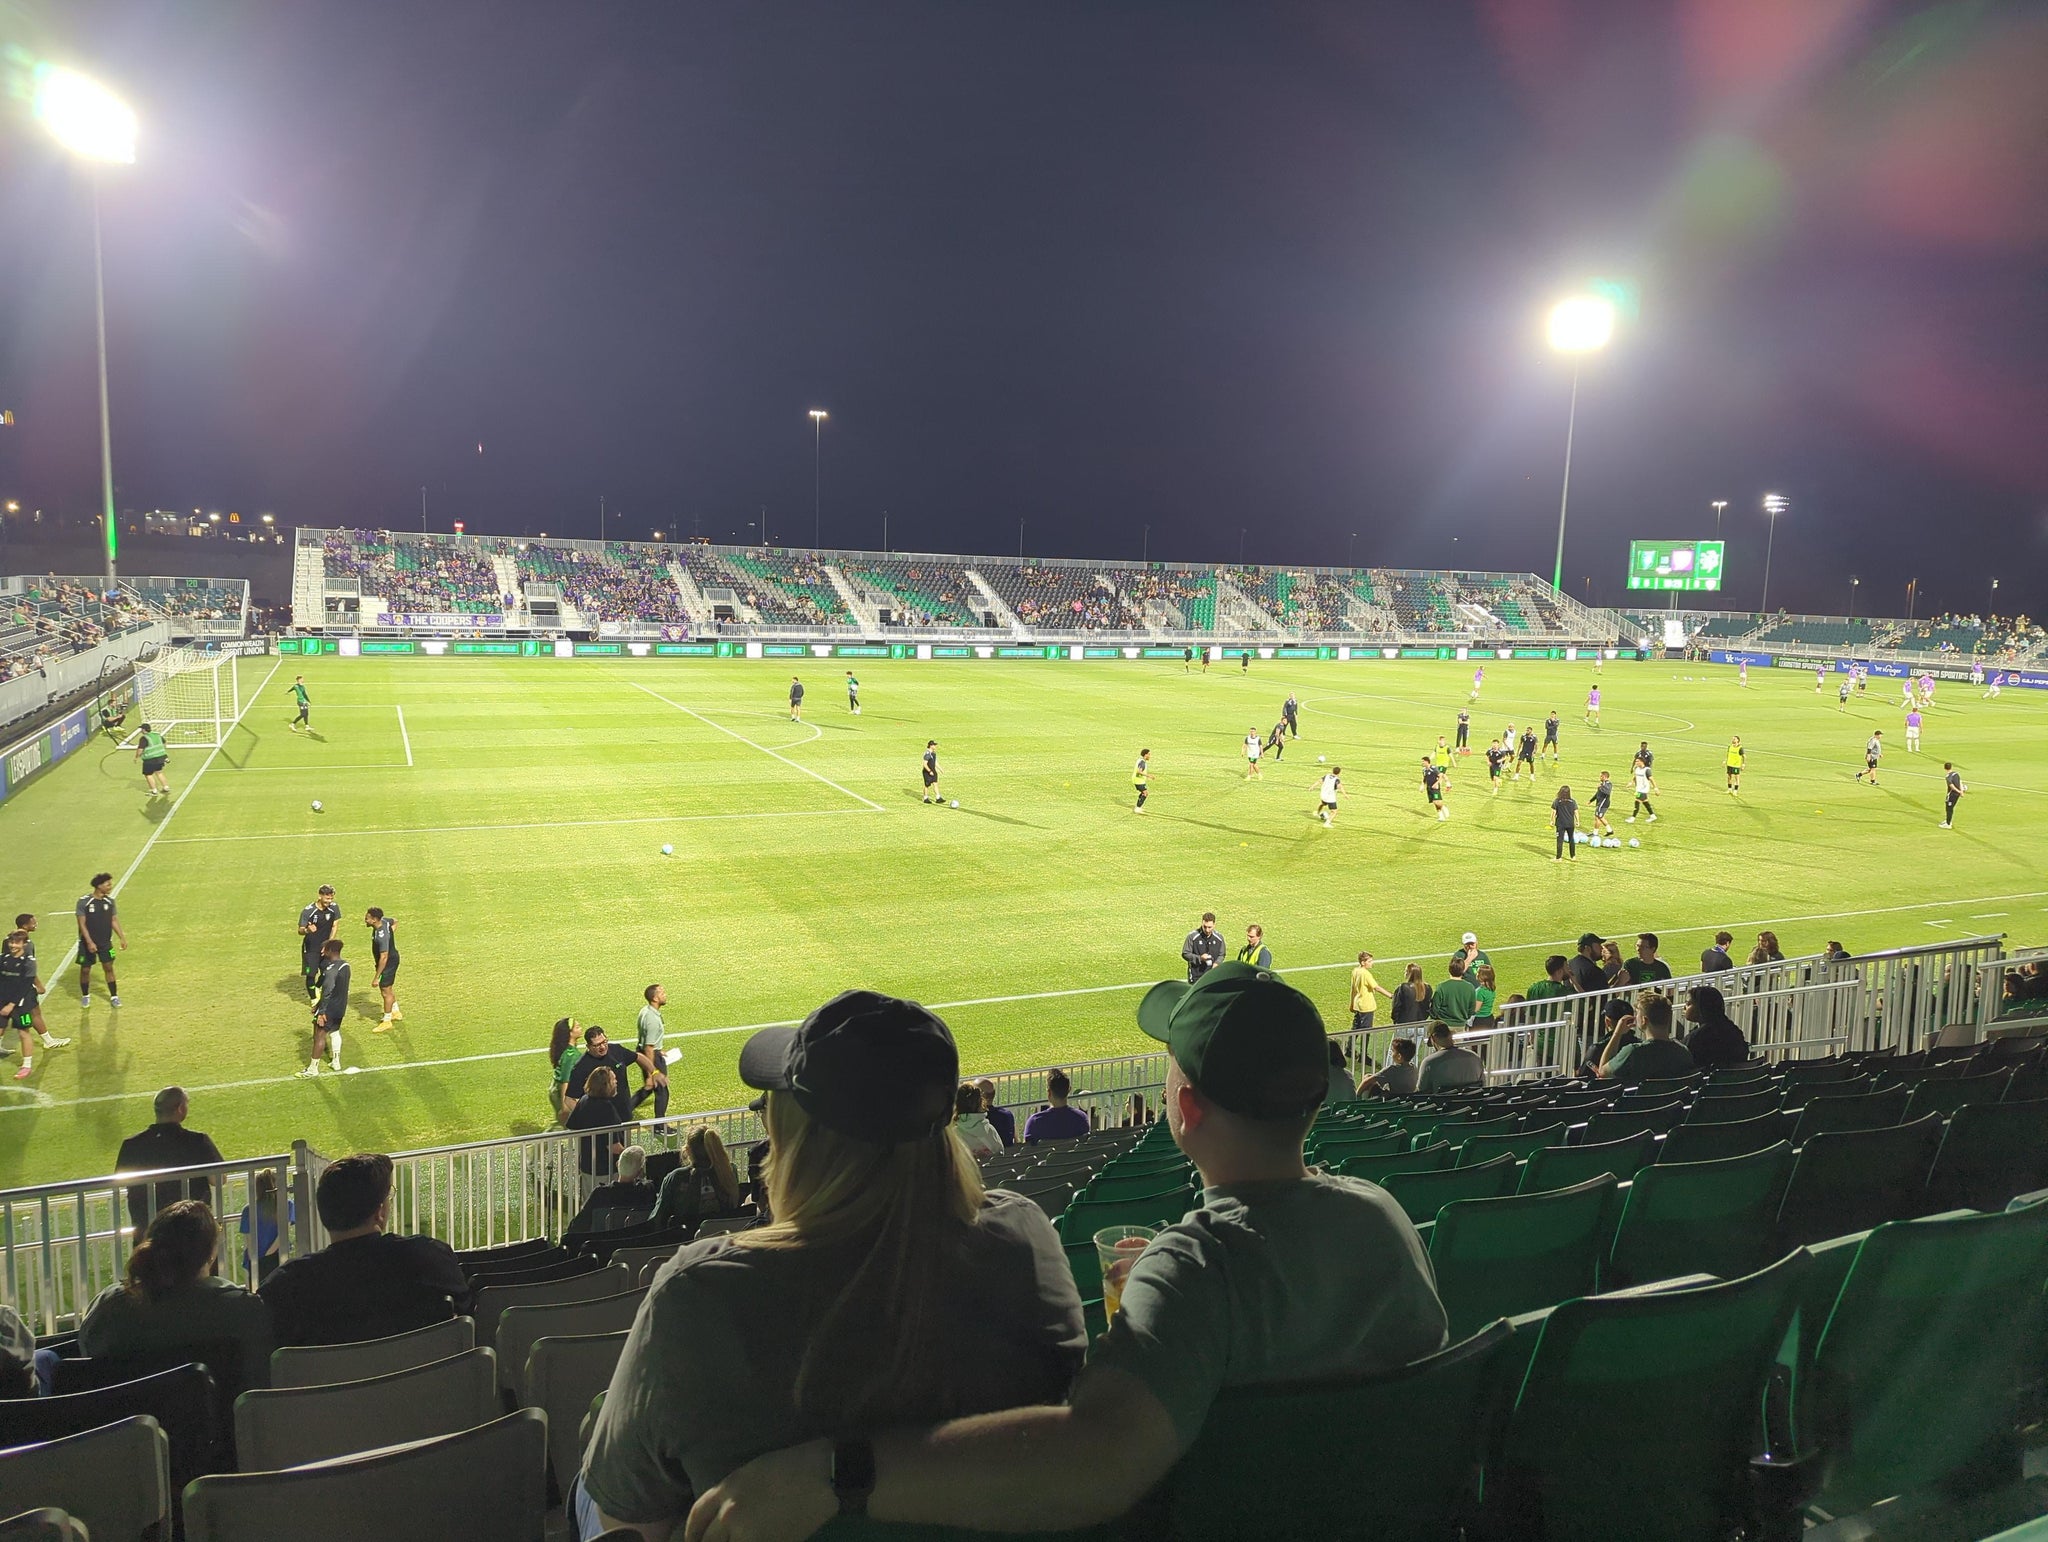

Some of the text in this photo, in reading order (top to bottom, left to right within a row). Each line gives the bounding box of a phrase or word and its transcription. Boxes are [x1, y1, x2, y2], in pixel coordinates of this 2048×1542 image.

[408, 614, 472, 625] THE COOPERS
[220, 640, 265, 649] COMMONWEALTH
[243, 646, 265, 656] UNION
[1882, 664, 1902, 677] Kroger
[1940, 670, 1969, 681] SPORTING
[1969, 672, 1985, 682] CB
[20, 1014, 32, 1026] 14
